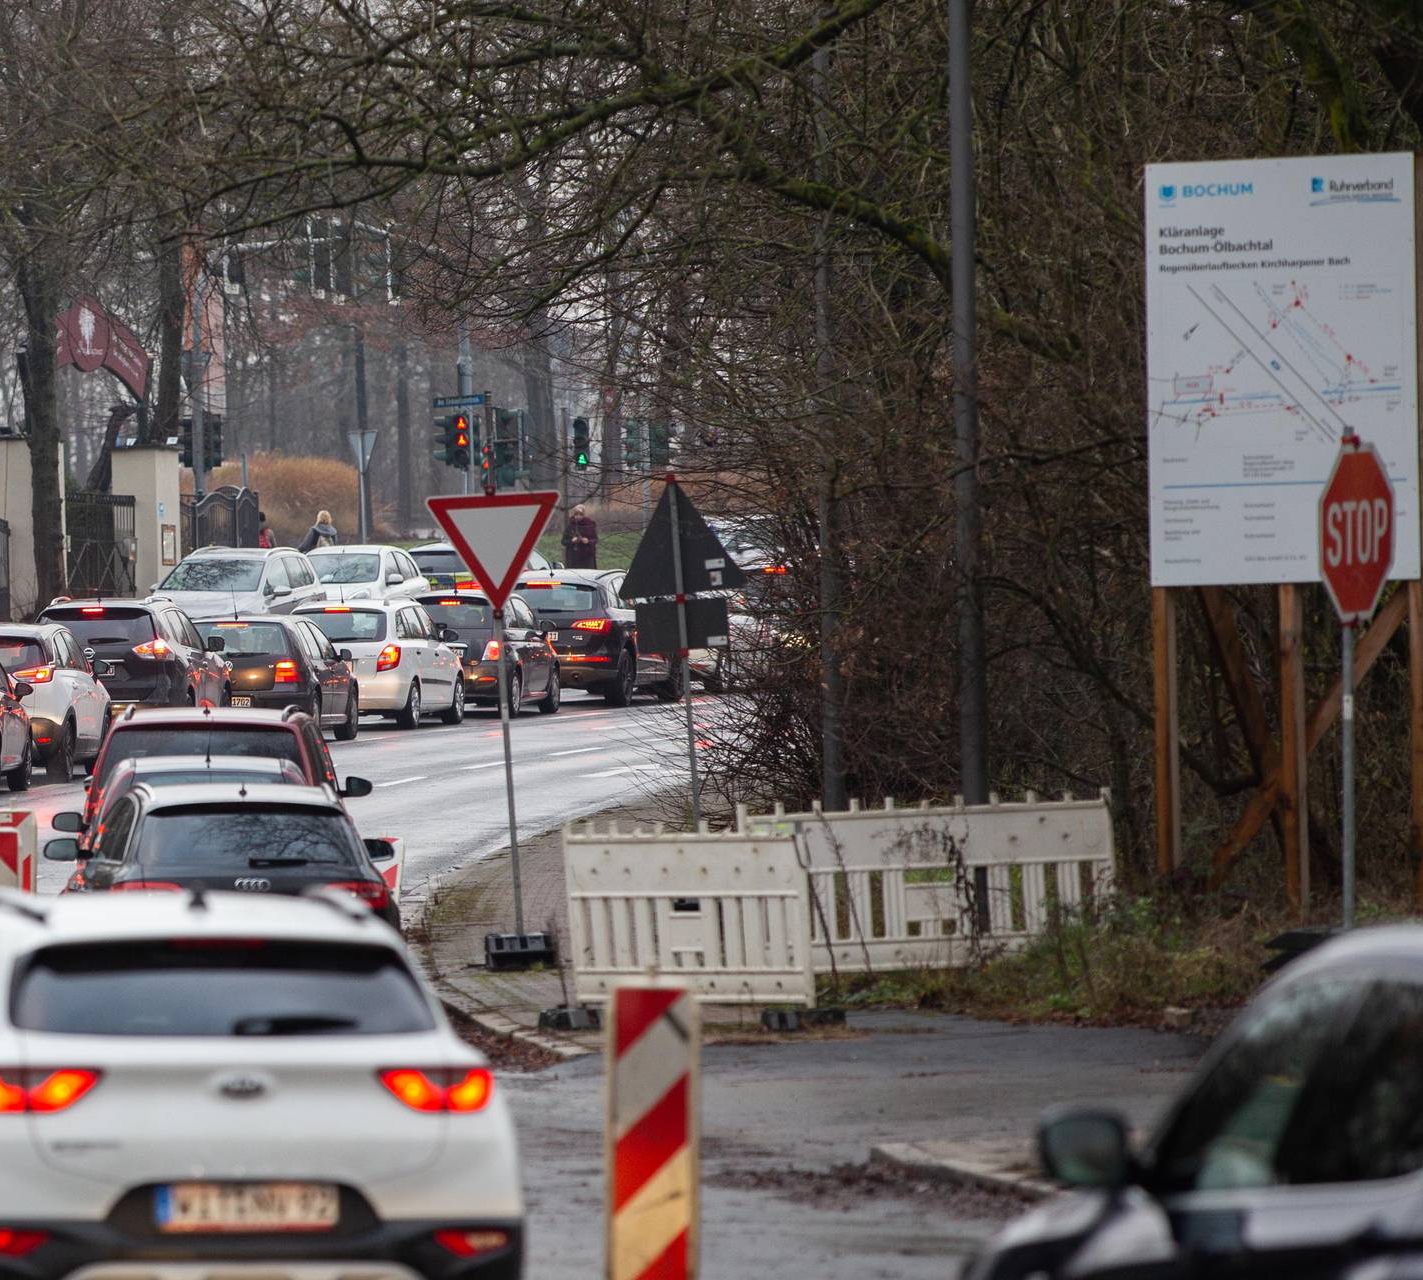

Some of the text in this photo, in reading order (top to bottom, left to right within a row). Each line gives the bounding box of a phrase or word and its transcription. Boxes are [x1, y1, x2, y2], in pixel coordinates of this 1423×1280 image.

[1182, 182, 1254, 198] BOCHUM
[1329, 178, 1394, 192] Ruhrverband
[1159, 226, 1225, 239] Kläranlage
[1159, 240, 1274, 255] Bochum-Ölbachtal
[1159, 260, 1258, 273] Regenüberlaufbecken
[1328, 256, 1351, 266] Bach
[1327, 498, 1389, 568] STOP
